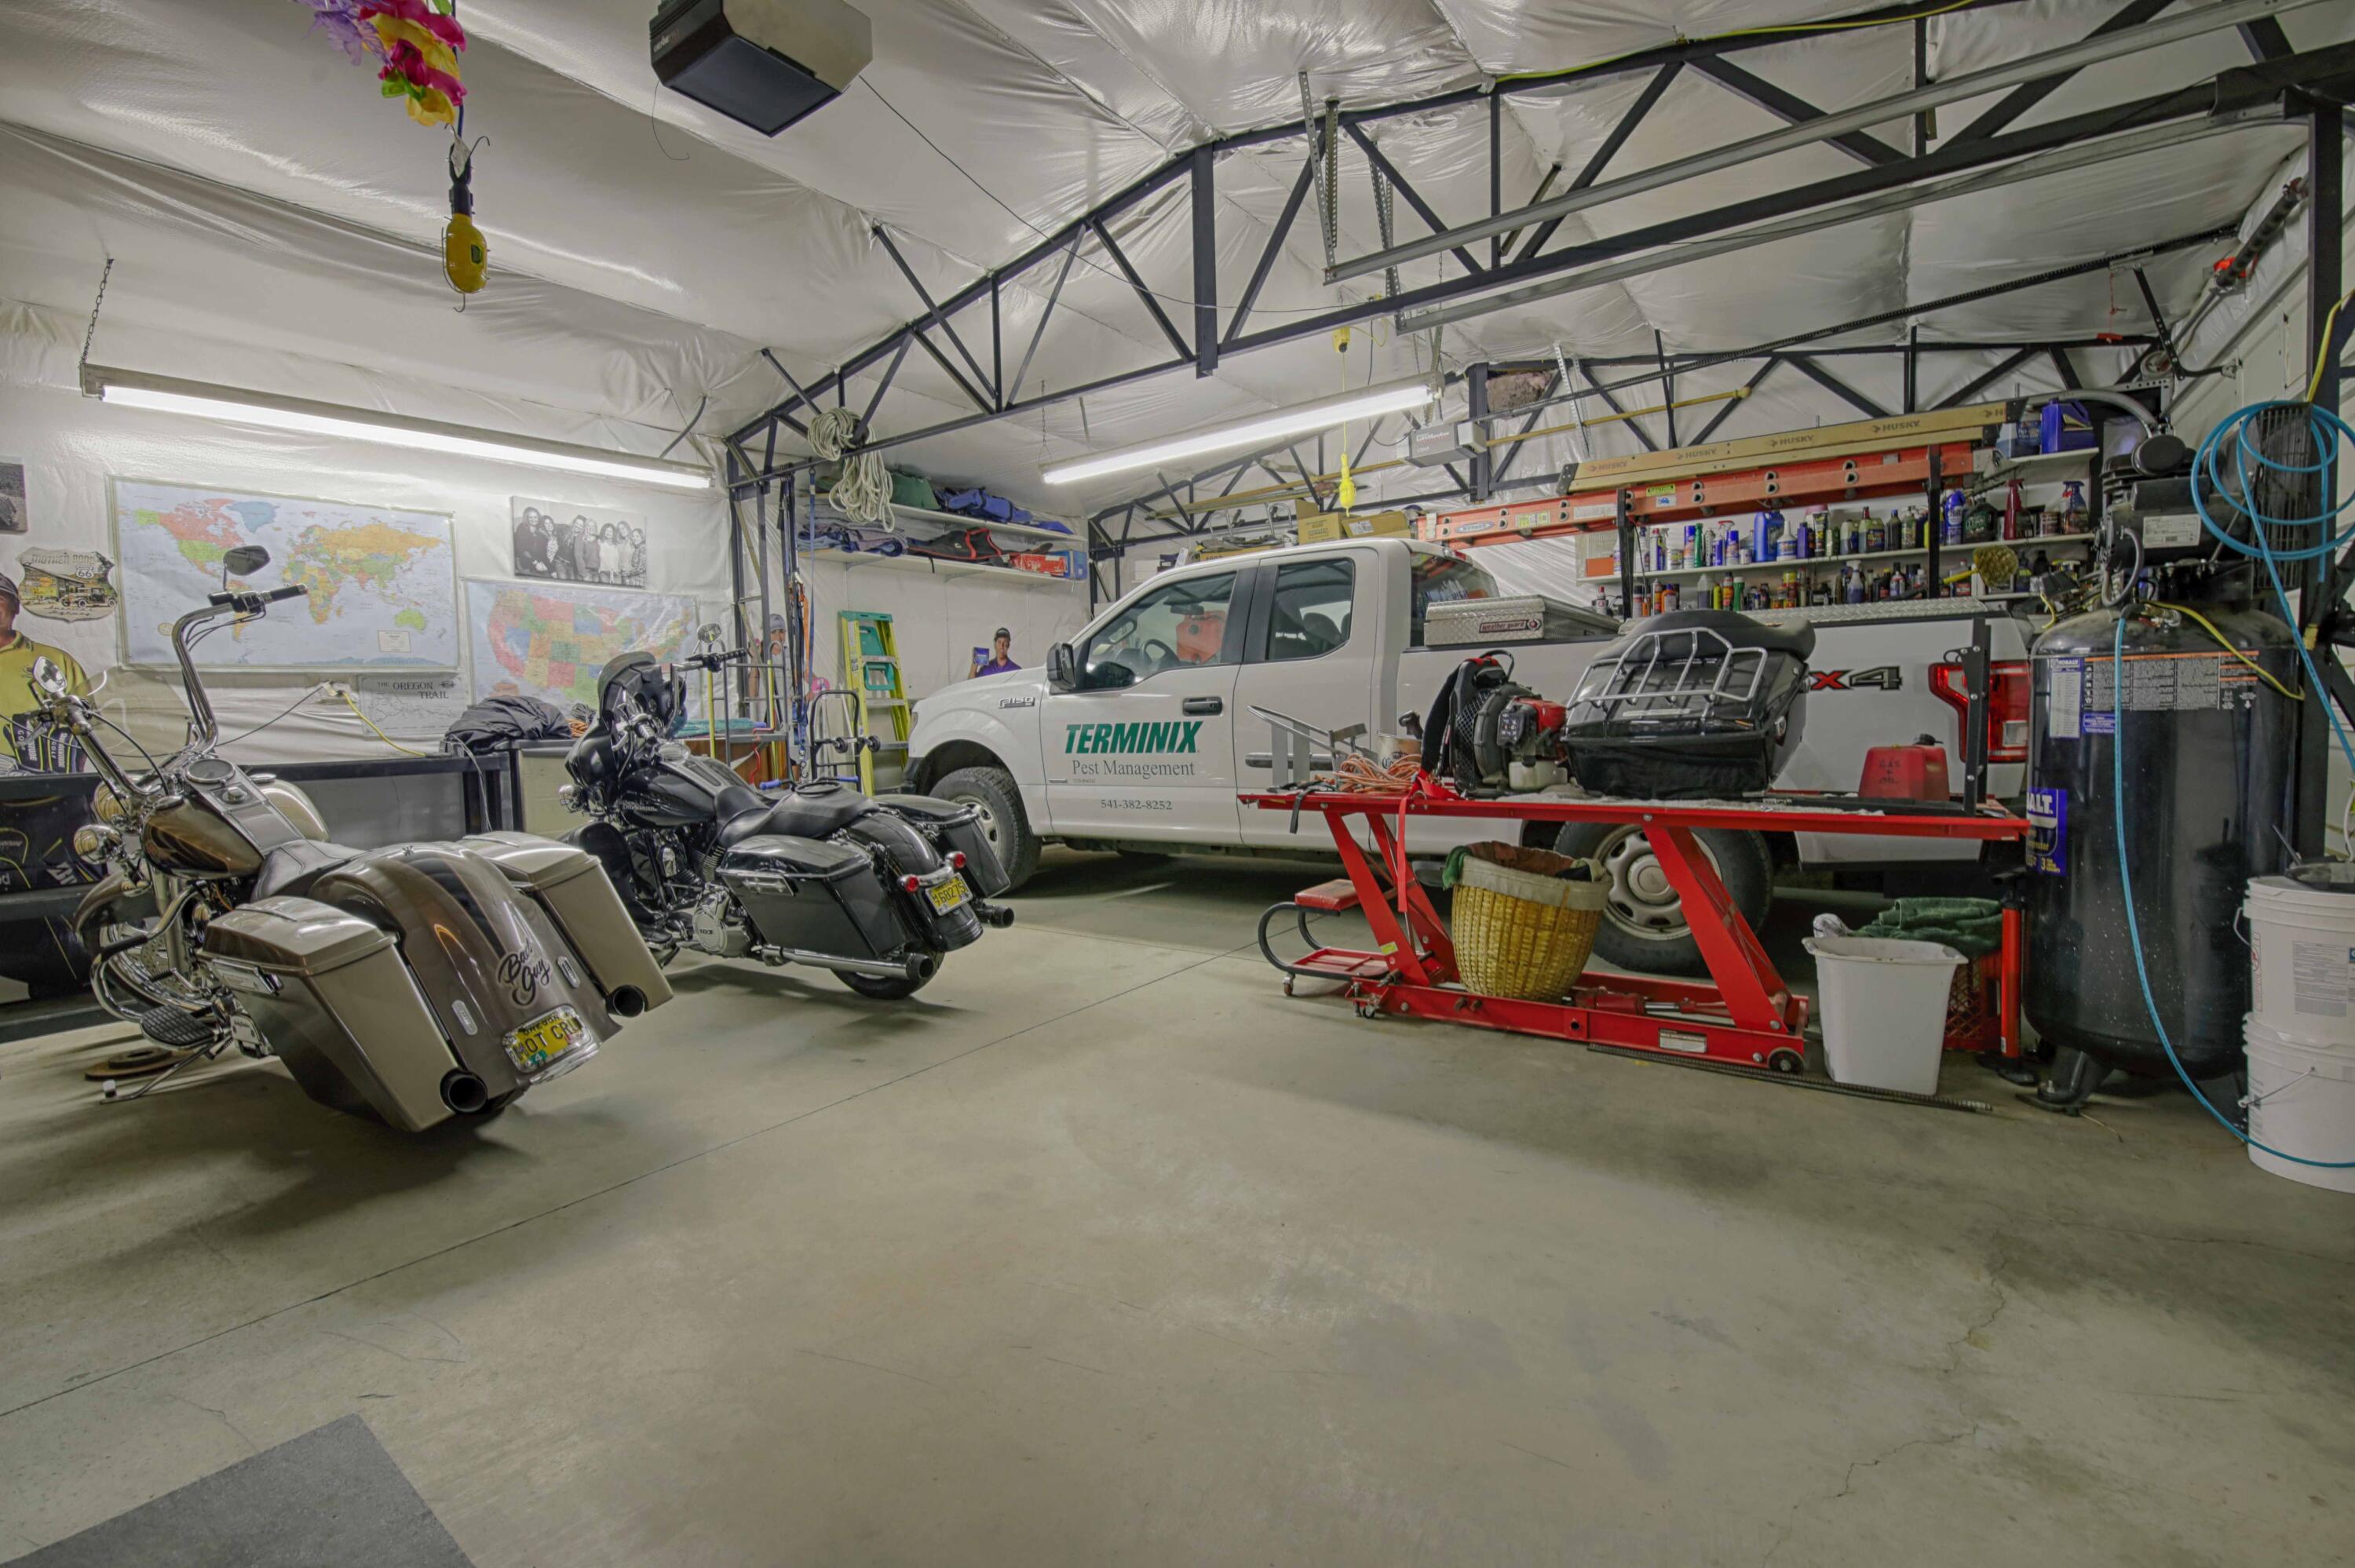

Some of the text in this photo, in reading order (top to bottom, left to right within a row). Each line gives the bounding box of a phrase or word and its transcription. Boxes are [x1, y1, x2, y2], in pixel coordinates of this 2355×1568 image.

[1882, 420, 1920, 432] HUSKY
[1780, 434, 1813, 446] HUSKY
[1685, 448, 1718, 460] HUSKY
[1598, 461, 1629, 471] HUSKY
[31, 553, 95, 565] MOTHER ROAD
[78, 570, 92, 578] 66
[1808, 665, 1903, 691] X4
[392, 681, 433, 691] OREGON
[418, 691, 449, 699] TRAIL
[1065, 720, 1204, 754] TERMINIX
[1072, 760, 1196, 780] Pest Management
[1101, 799, 1173, 811] 541-382-8252
[498, 938, 533, 985] Bad
[512, 958, 550, 1006] Guy
